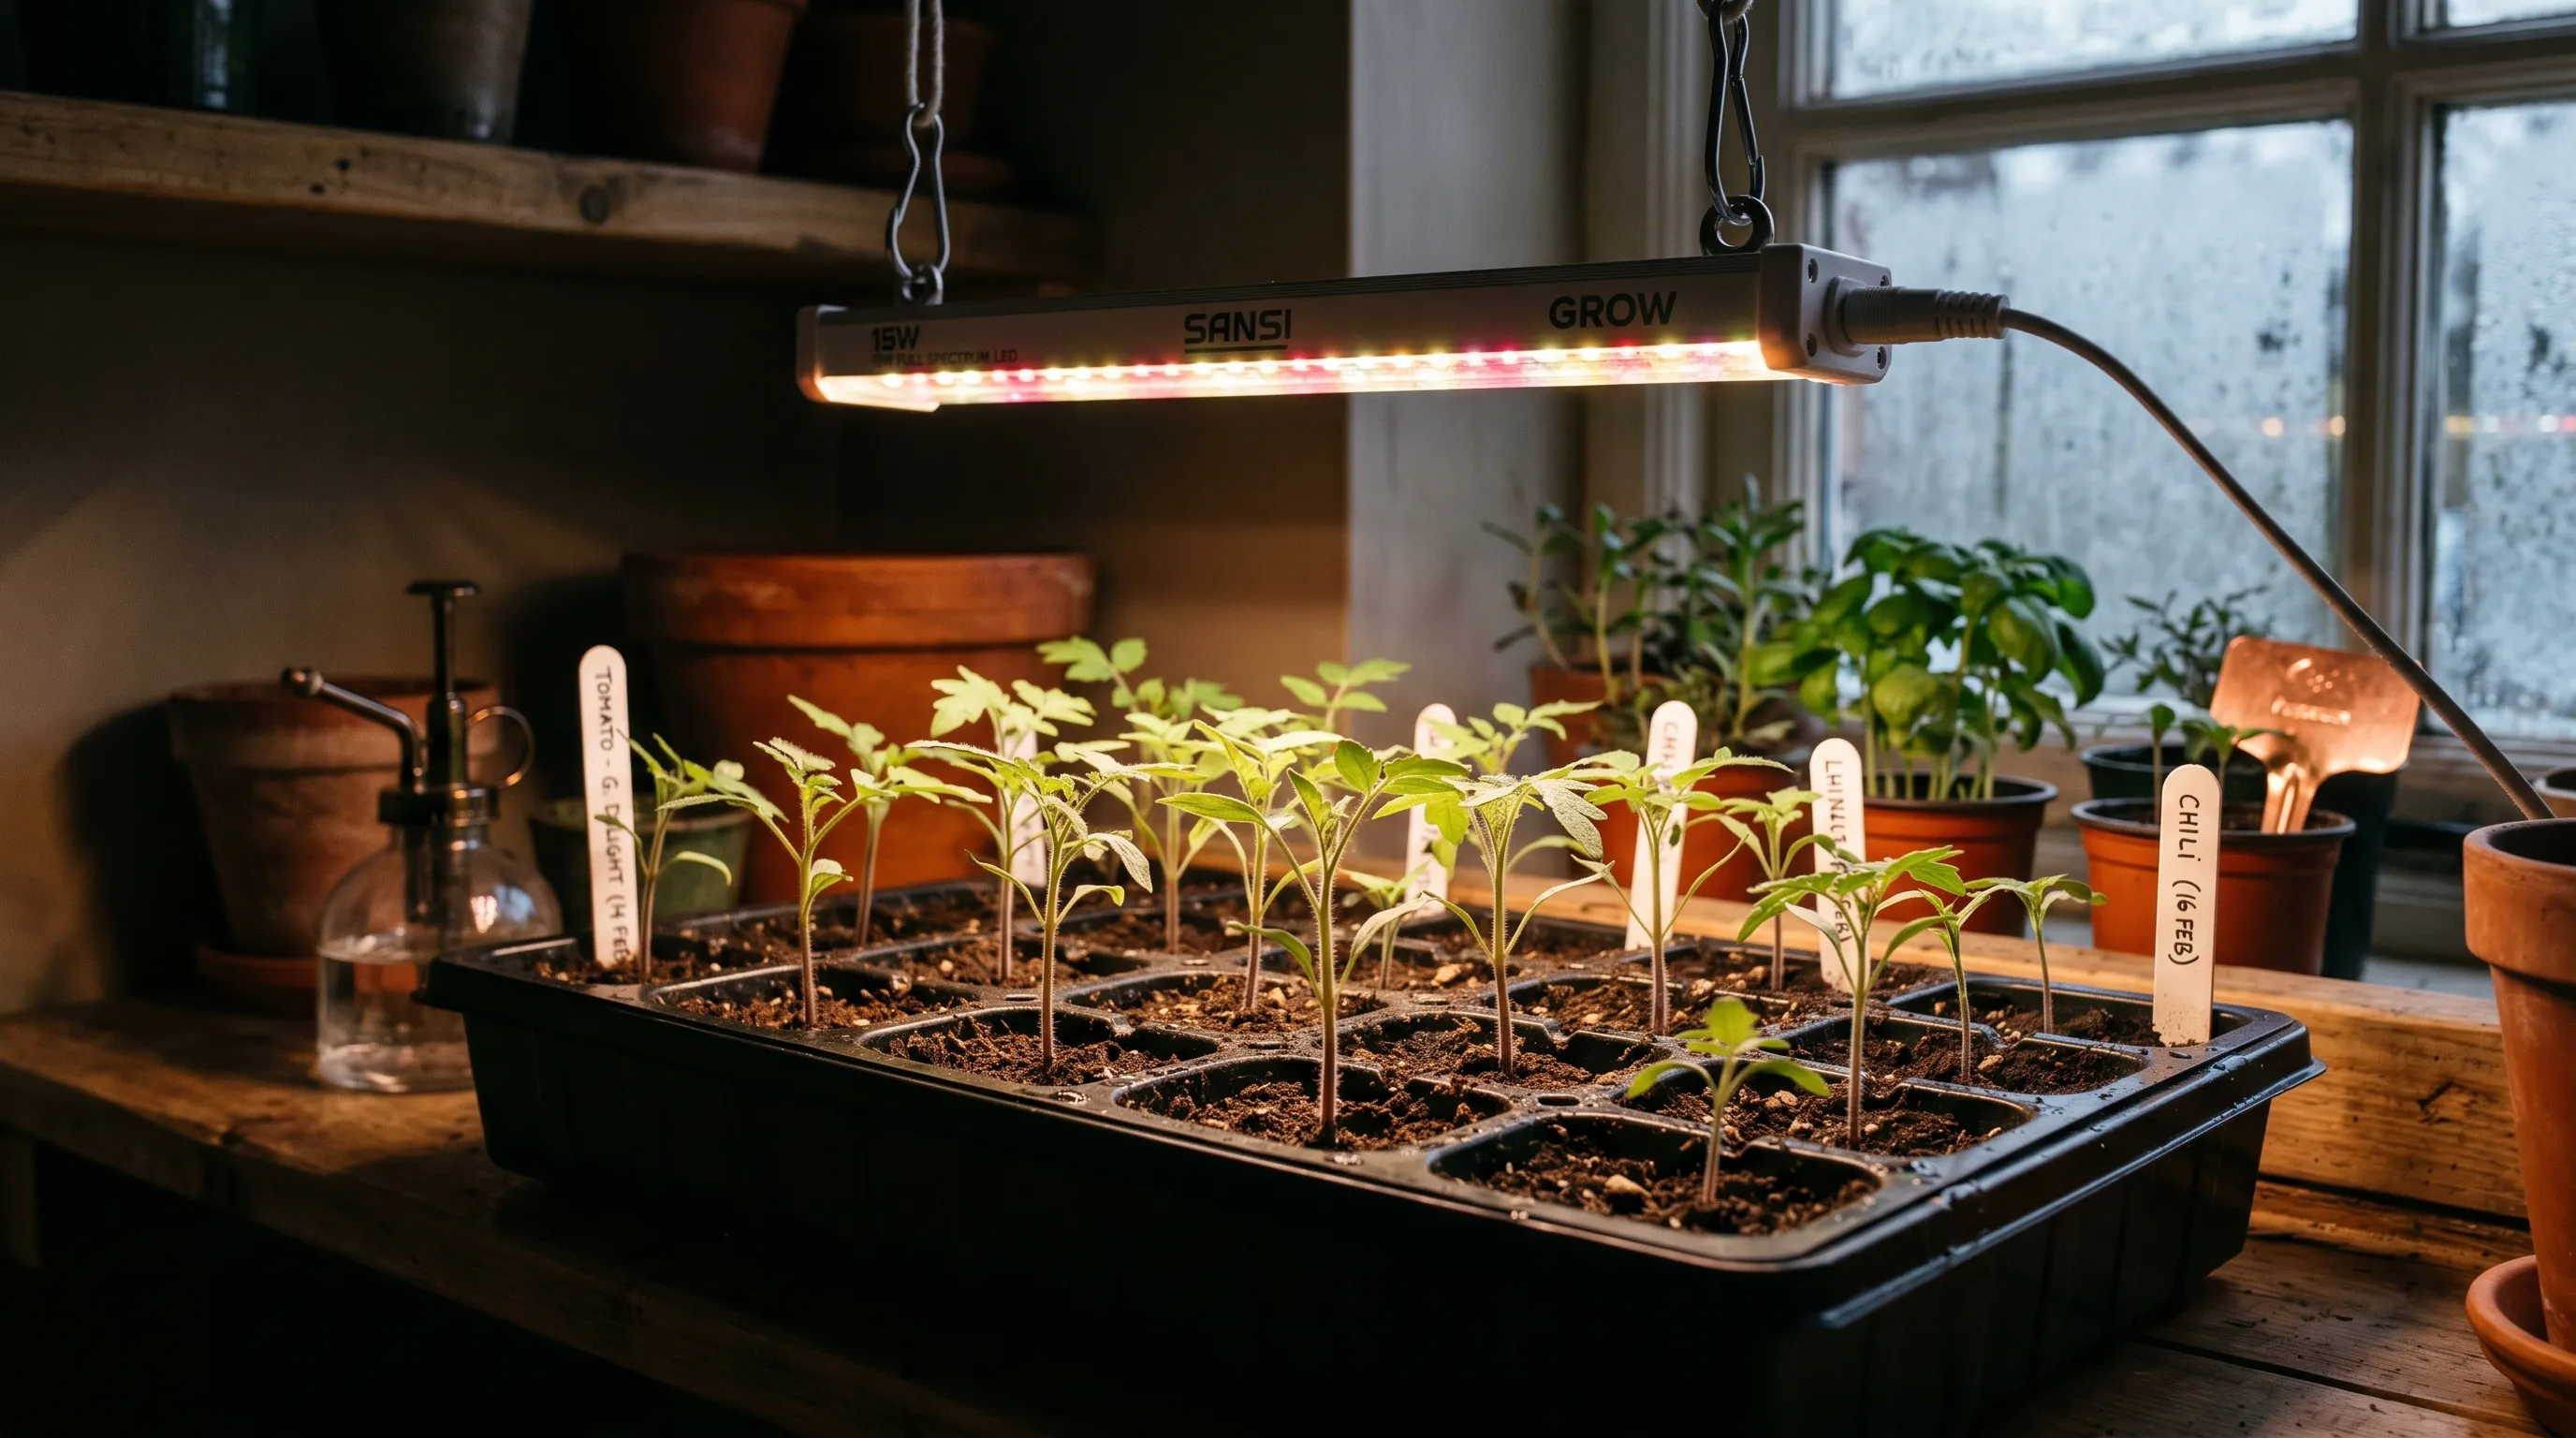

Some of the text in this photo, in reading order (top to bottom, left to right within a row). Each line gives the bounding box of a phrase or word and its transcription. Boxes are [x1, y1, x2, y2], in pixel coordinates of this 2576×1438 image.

[1184, 309, 1292, 345] SANSI
[1549, 291, 1677, 330] GROW
[871, 325, 920, 352] 15W
[927, 350, 989, 365] SPECTRUM
[993, 348, 1018, 363] LED
[595, 665, 614, 752] TOMATO
[605, 804, 625, 885] DLIGHT
[2173, 880, 2201, 912] (16
[2168, 918, 2199, 965] FEB)
